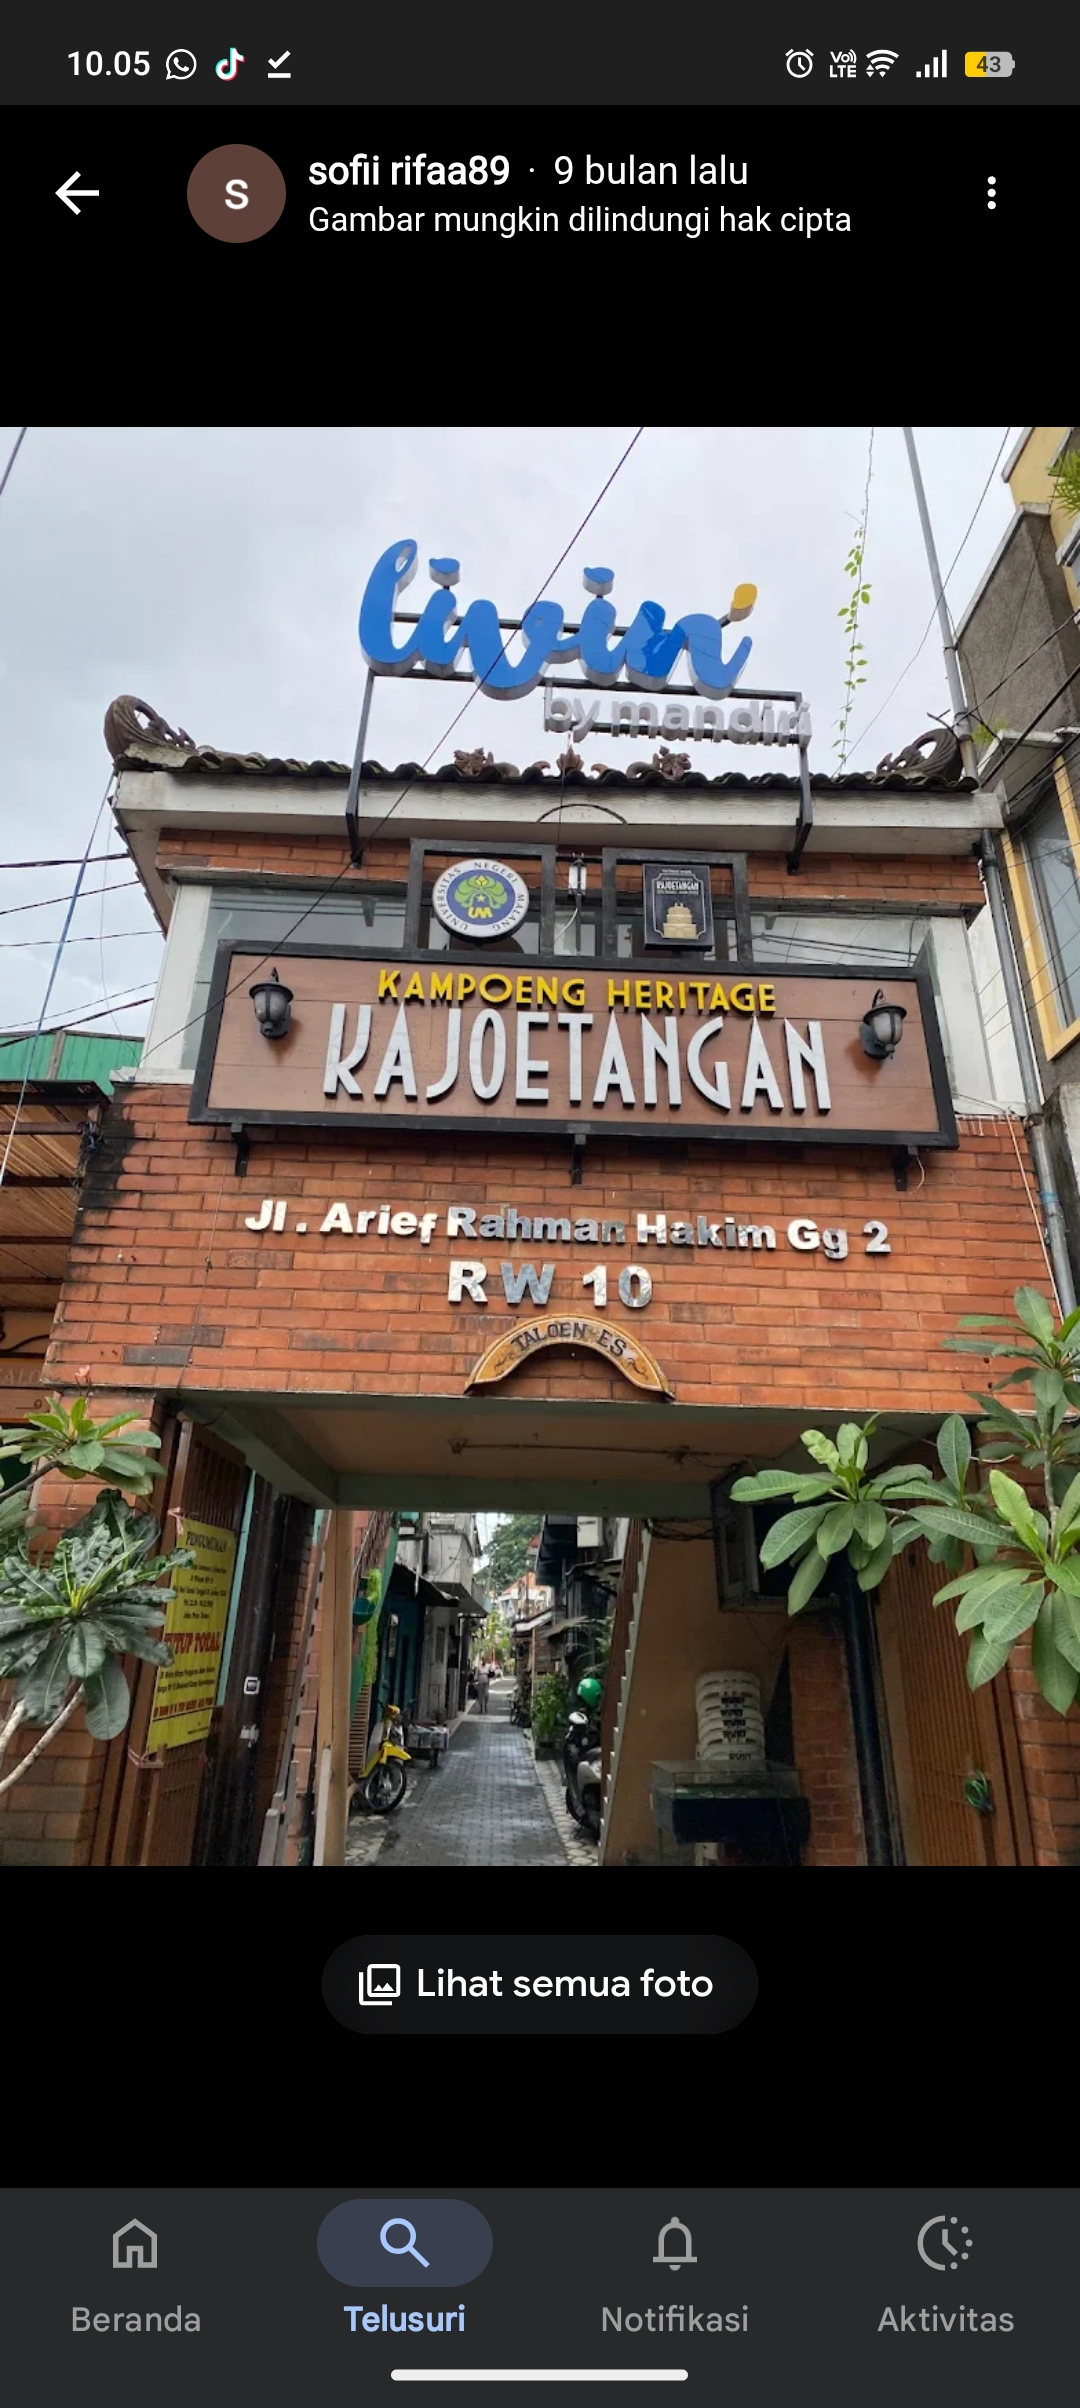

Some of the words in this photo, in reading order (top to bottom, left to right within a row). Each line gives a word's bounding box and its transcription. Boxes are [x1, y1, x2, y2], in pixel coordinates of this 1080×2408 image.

[544, 694, 600, 742] by
[612, 699, 811, 747] mandiri
[473, 861, 518, 883] NEGERI
[436, 867, 469, 931] UNIVERSITAS
[468, 907, 493, 918] UM
[492, 893, 525, 932] MALANG
[378, 969, 586, 1007] KAMPOENG
[607, 978, 776, 1013] HERITAGE
[322, 1003, 831, 1112] KAJOETANGAN
[319, 1201, 437, 1245] Arief
[446, 1206, 626, 1245] Rahman
[636, 1213, 776, 1250] Hakim
[787, 1219, 848, 1260] Gg
[863, 1221, 891, 1254] 2
[447, 1260, 555, 1306] RW
[583, 1264, 653, 1309] 10
[511, 1321, 589, 1352] TALOEN
[597, 1328, 627, 1356] ES
